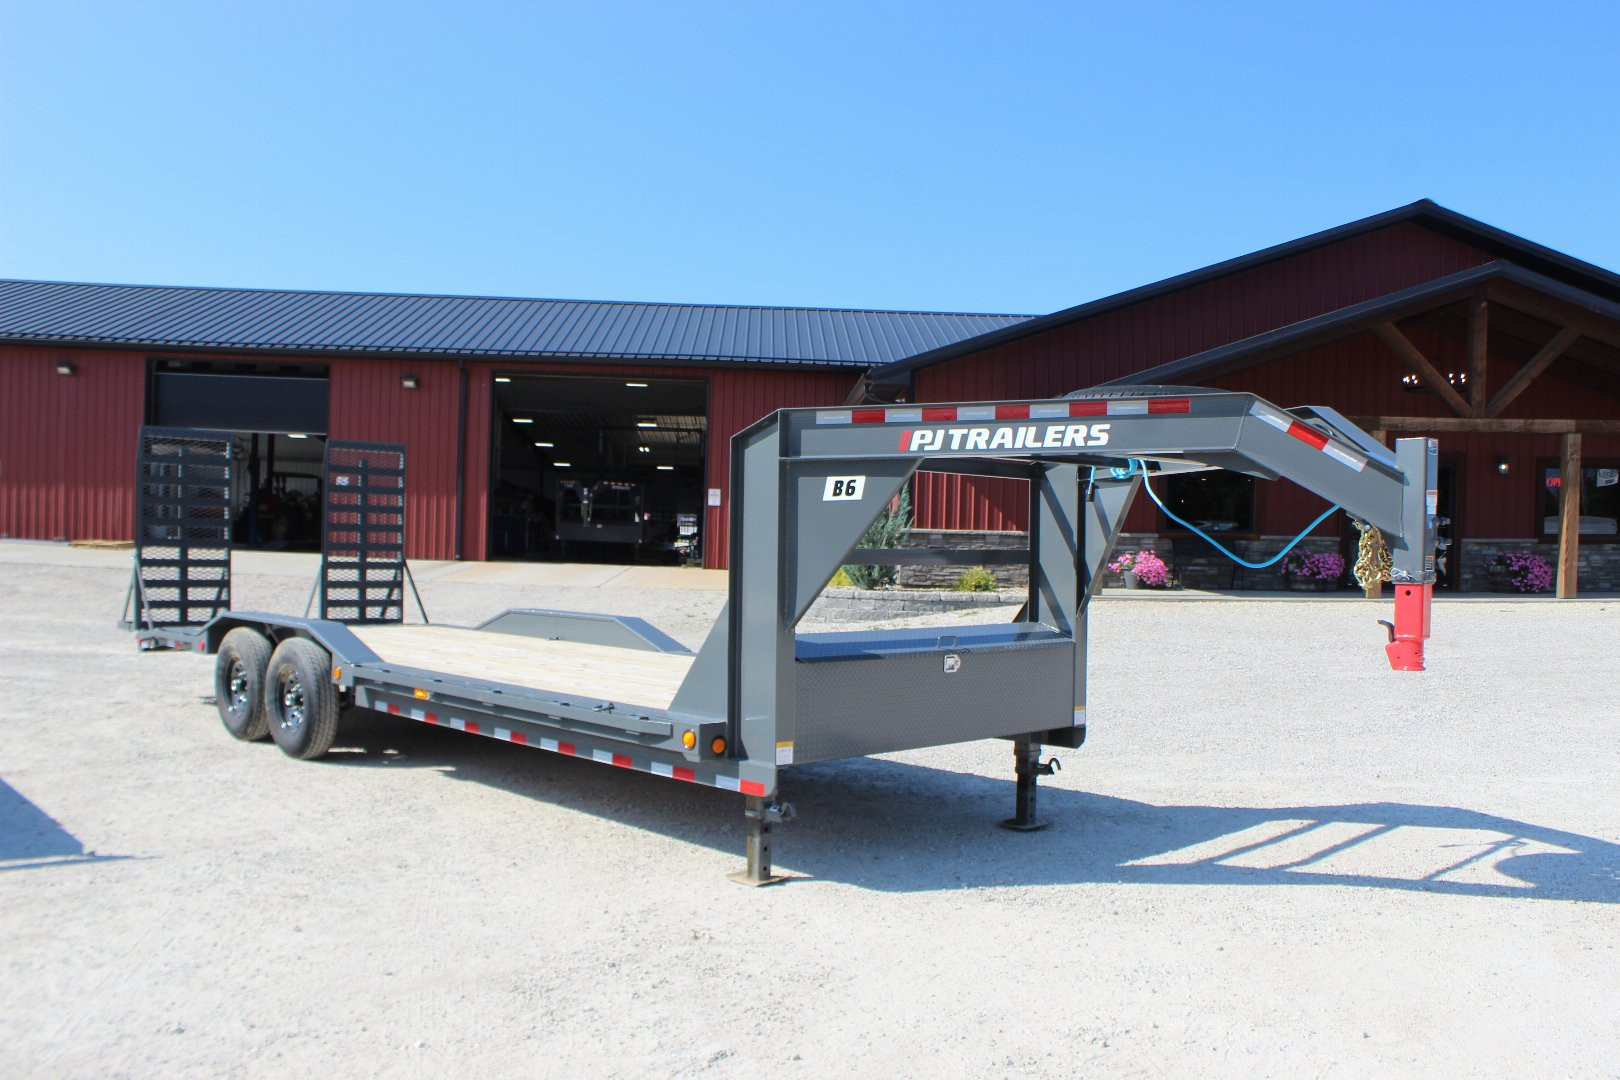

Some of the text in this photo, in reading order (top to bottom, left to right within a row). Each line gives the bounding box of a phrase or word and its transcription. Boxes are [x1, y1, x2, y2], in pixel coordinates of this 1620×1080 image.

[909, 423, 1111, 451] PJ TRAILERS
[832, 479, 857, 497] B6
